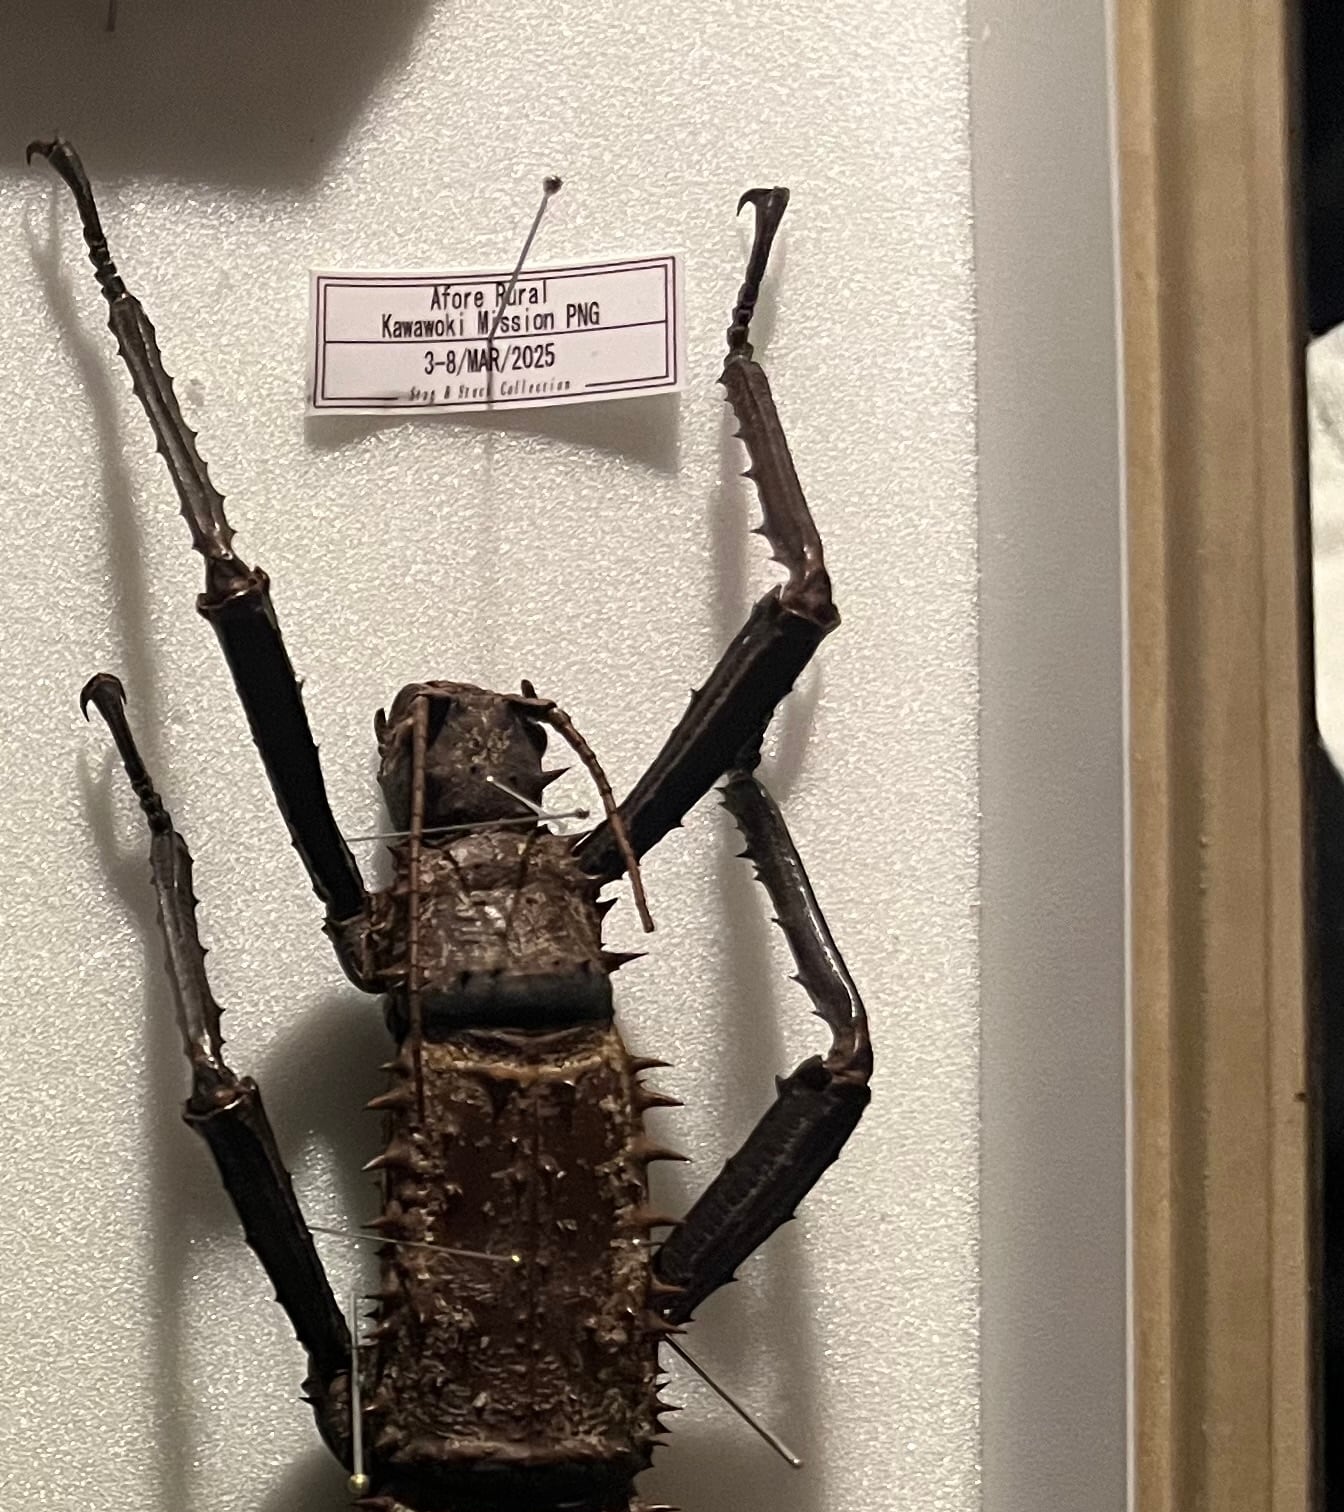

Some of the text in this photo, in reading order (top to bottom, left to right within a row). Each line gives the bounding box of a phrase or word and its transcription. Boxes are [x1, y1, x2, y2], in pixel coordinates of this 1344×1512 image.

[430, 279, 548, 311] Afore Rural
[381, 302, 601, 339] Kawawoki Mission PNG
[424, 343, 556, 376] 3-8/MAR/2025
[500, 377, 571, 396] Collection
